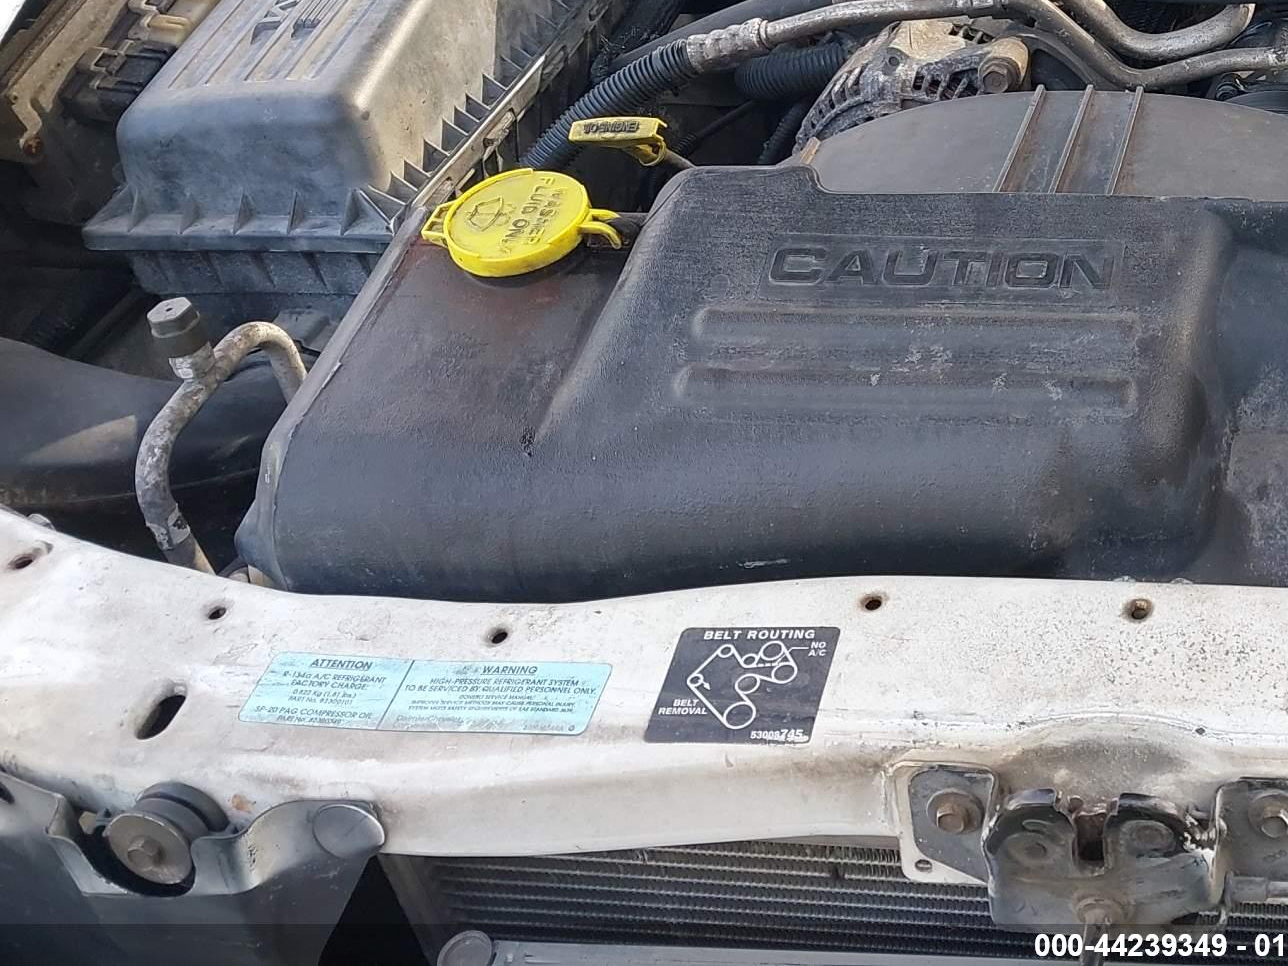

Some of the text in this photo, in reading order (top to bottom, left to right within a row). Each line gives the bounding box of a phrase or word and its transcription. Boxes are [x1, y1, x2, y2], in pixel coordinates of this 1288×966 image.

[520, 176, 557, 214] FLUID
[768, 248, 1114, 290] CAUTION
[703, 629, 816, 640] BELT ROUTING
[810, 641, 827, 649] NO
[807, 648, 827, 657] A/C
[310, 658, 374, 671] ATTENTION
[481, 665, 538, 676] WARNING
[314, 673, 332, 681] A/C
[332, 674, 387, 684] REFRIGERANT
[430, 677, 580, 687] HIGH-PRESSURE REFRIGERANT SYSTEM
[290, 679, 331, 689] FACTORY
[428, 685, 468, 693] SERVICED
[469, 685, 481, 693] BY
[482, 686, 524, 694] QUALIFIED
[525, 686, 572, 695] PERSONNEL
[573, 687, 597, 695] ONLY.
[672, 699, 698, 707] BELT
[279, 707, 299, 715] PAG
[299, 709, 359, 719] COMPRESSOR
[358, 711, 373, 720] OIL
[657, 707, 708, 716] REMOVAL
